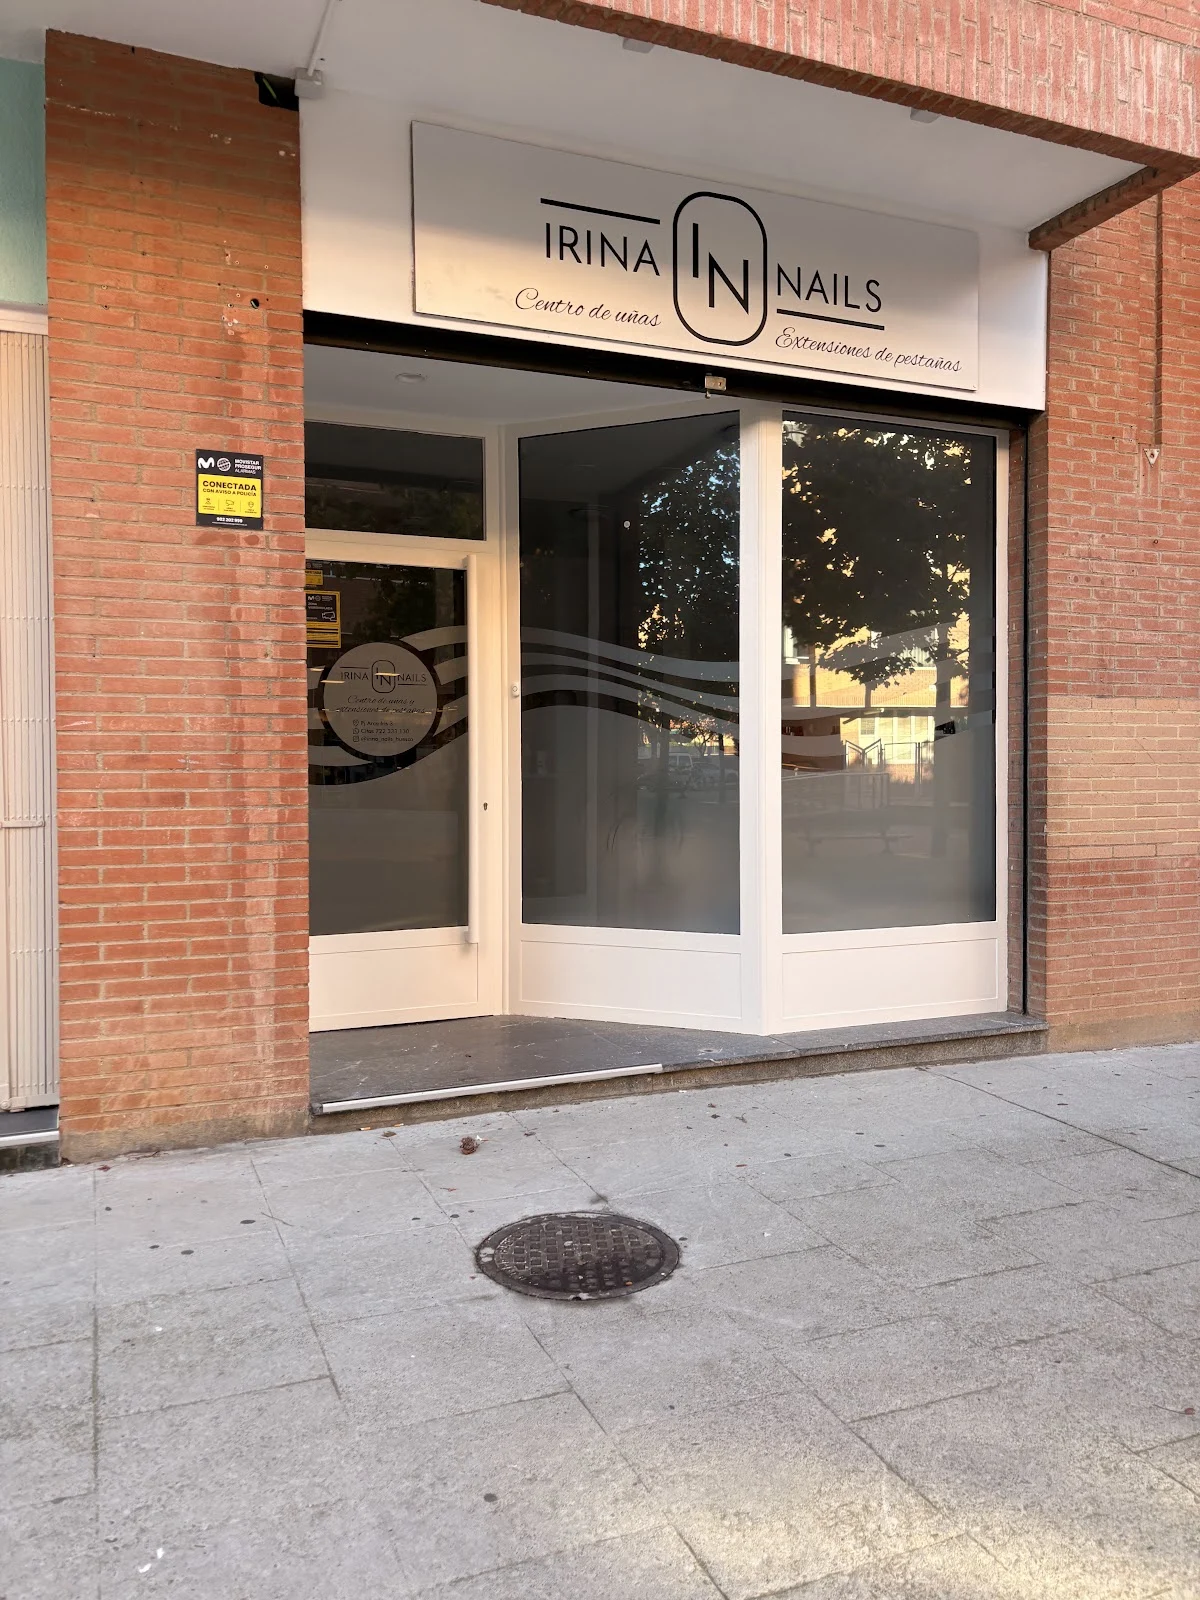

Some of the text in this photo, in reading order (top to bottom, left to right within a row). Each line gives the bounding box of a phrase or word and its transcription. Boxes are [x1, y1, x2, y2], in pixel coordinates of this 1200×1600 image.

[545, 223, 882, 314] IRINA IN NAILS
[515, 286, 662, 328] Centro de uñas
[774, 326, 962, 373] Extensiones de pestañas
[203, 481, 256, 491] CONECTADA
[340, 671, 369, 681] IRINA
[397, 672, 427, 683] NAILS
[347, 695, 376, 704] Centro
